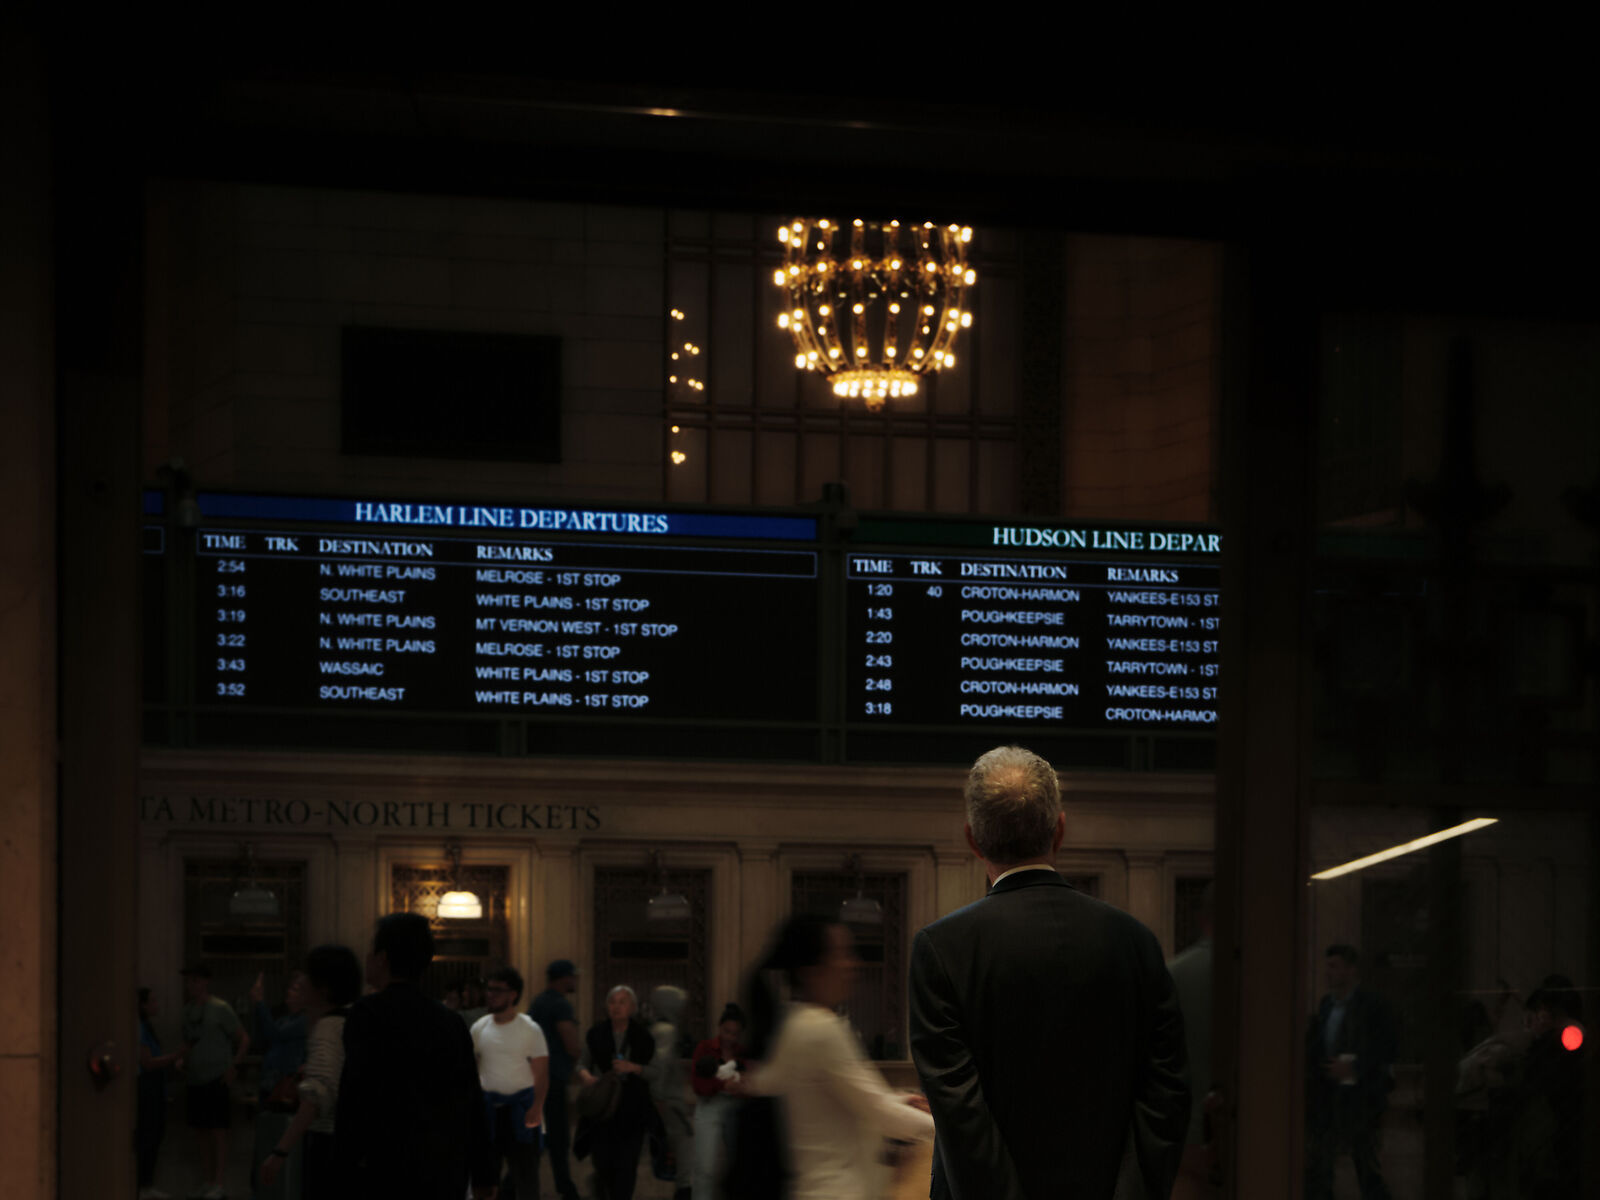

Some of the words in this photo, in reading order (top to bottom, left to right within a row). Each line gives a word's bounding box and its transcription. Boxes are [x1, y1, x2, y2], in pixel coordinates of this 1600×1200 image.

[355, 503, 453, 525] HARLEM
[459, 507, 515, 528] LINE
[520, 509, 669, 533] DEPARTURES
[204, 535, 245, 549] TIME
[265, 537, 299, 551] TRK
[320, 539, 433, 556] DESTINATION
[477, 545, 553, 561] REMARKS
[993, 527, 1086, 547] HUDSON
[1093, 531, 1144, 549] LINE
[1150, 533, 1222, 552] DEPAR
[218, 560, 245, 572] 2:54
[338, 564, 382, 578] WHITE
[387, 566, 436, 580] PLAINS
[476, 570, 543, 584] MELROSE
[557, 573, 580, 586] 1ST
[584, 574, 621, 587] STOP
[853, 559, 893, 573] TIME
[910, 561, 942, 575] TRK
[961, 563, 1067, 578] DESTINATION
[1108, 568, 1179, 582] REMARKS
[218, 585, 246, 597] 3:16
[320, 588, 405, 603] SOUTHEAST
[476, 594, 520, 608] WHITE
[524, 595, 573, 610] PLAINS
[585, 598, 609, 610] 1ST
[613, 598, 650, 612] STOP
[868, 584, 893, 596] 1:20
[927, 586, 942, 598] 40
[961, 586, 1080, 602] CROTON-HARMON
[218, 609, 246, 622] 3:19
[337, 613, 382, 627] WHITE
[386, 614, 435, 629] PLAINS
[476, 618, 496, 630] MT
[500, 619, 559, 632] VERNON
[561, 621, 601, 634] WEST
[614, 623, 638, 636] 1ST
[641, 624, 678, 637] STOP
[868, 608, 892, 620] 1:43
[961, 610, 1064, 625] POUGHKEEPSIE
[1107, 614, 1188, 628] TARRYTOWN
[218, 634, 245, 647] 3:22
[337, 638, 382, 651] WHITE
[386, 639, 435, 653] PLAINS
[476, 642, 543, 657] MELROSE
[557, 645, 580, 658] 1ST
[583, 646, 620, 659] STOP
[866, 631, 892, 643] 2:20
[961, 633, 1079, 648] CROTON-HARMON
[218, 658, 245, 671] 3:43
[320, 662, 384, 676] WASSAIC
[476, 667, 520, 680] WHITE
[524, 668, 572, 682] PLAINS
[585, 670, 608, 683] 1ST
[612, 671, 649, 684] STOP
[866, 655, 892, 667] 2:43
[961, 657, 1064, 672] POUGHKEEPSIE
[1107, 661, 1187, 675] TARRYTOWN
[218, 683, 245, 696] 3:52
[320, 686, 405, 701] SOUTHEAST
[475, 691, 520, 704] WHITE
[523, 692, 572, 706] PLAINS
[585, 694, 608, 707] 1ST
[612, 695, 649, 708] STOP
[866, 678, 892, 691] 2:48
[960, 680, 1079, 696] CROTON-HARMON
[866, 702, 891, 714] 3:18
[961, 704, 1062, 719] POUGHKEEPSIE
[189, 797, 450, 828] METRO-NORTH
[463, 802, 601, 831] TICKETS
